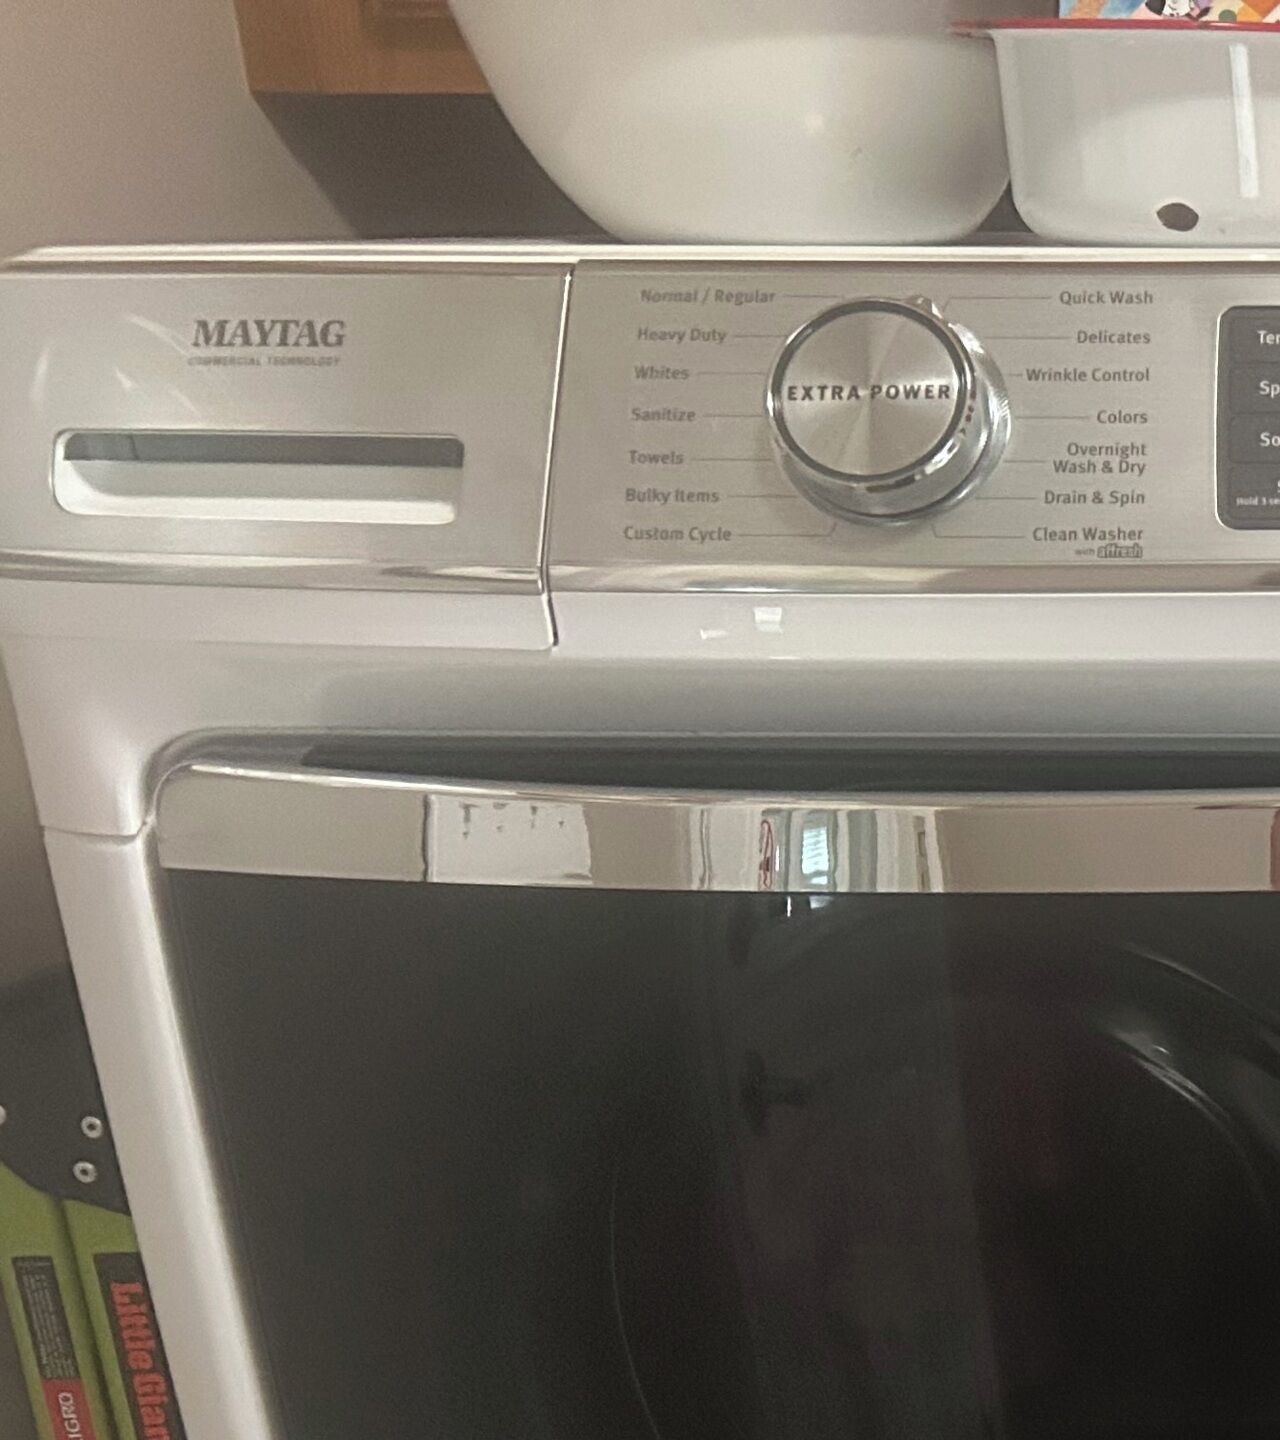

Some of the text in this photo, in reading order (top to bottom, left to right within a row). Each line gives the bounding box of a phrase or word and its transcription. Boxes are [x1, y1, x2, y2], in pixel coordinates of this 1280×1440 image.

[640, 288, 698, 303] Normal
[715, 288, 775, 306] Regular
[1059, 291, 1154, 306] Quick Wash
[191, 318, 346, 348] MAYTAG
[638, 327, 727, 345] Heavy Duty
[1077, 331, 1150, 345] Delicates
[635, 366, 690, 381] Whites
[1027, 368, 1149, 383] Wrinkle Control
[788, 384, 951, 400] EXTRA POWER
[632, 408, 696, 423] Sanitize
[1097, 410, 1148, 425] Colors
[629, 451, 684, 465] Towels
[1067, 442, 1147, 460] Overnight
[1053, 460, 1146, 479] Wash & Dry
[625, 488, 720, 505] Bulky Items
[1044, 490, 1145, 508] Drain & Spin
[624, 527, 731, 544] Custom Cycle
[1033, 527, 1143, 542] Clean Washer
[110, 1282, 154, 1369] Little
